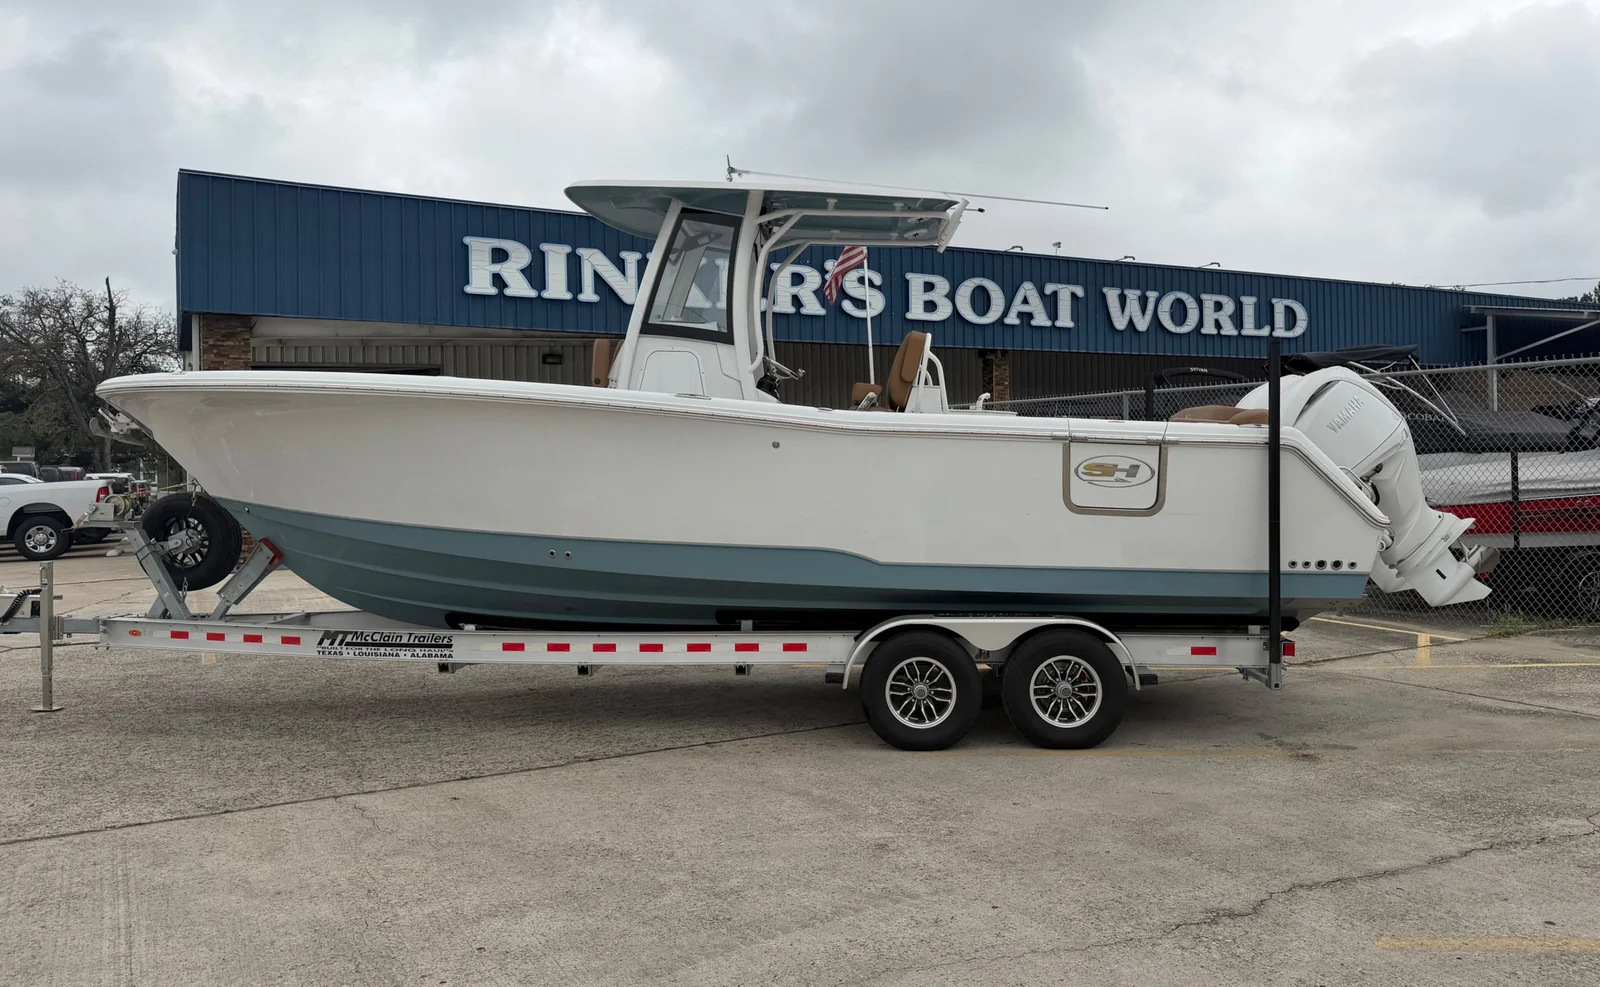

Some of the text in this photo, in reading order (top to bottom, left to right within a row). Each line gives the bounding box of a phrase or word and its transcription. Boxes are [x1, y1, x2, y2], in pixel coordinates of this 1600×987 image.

[463, 236, 1309, 338] RINR'S BOAT WORLD
[1326, 395, 1364, 434] YAMAHA
[1081, 462, 1141, 478] SH
[351, 631, 403, 643] McClain
[407, 632, 453, 644] Trailers
